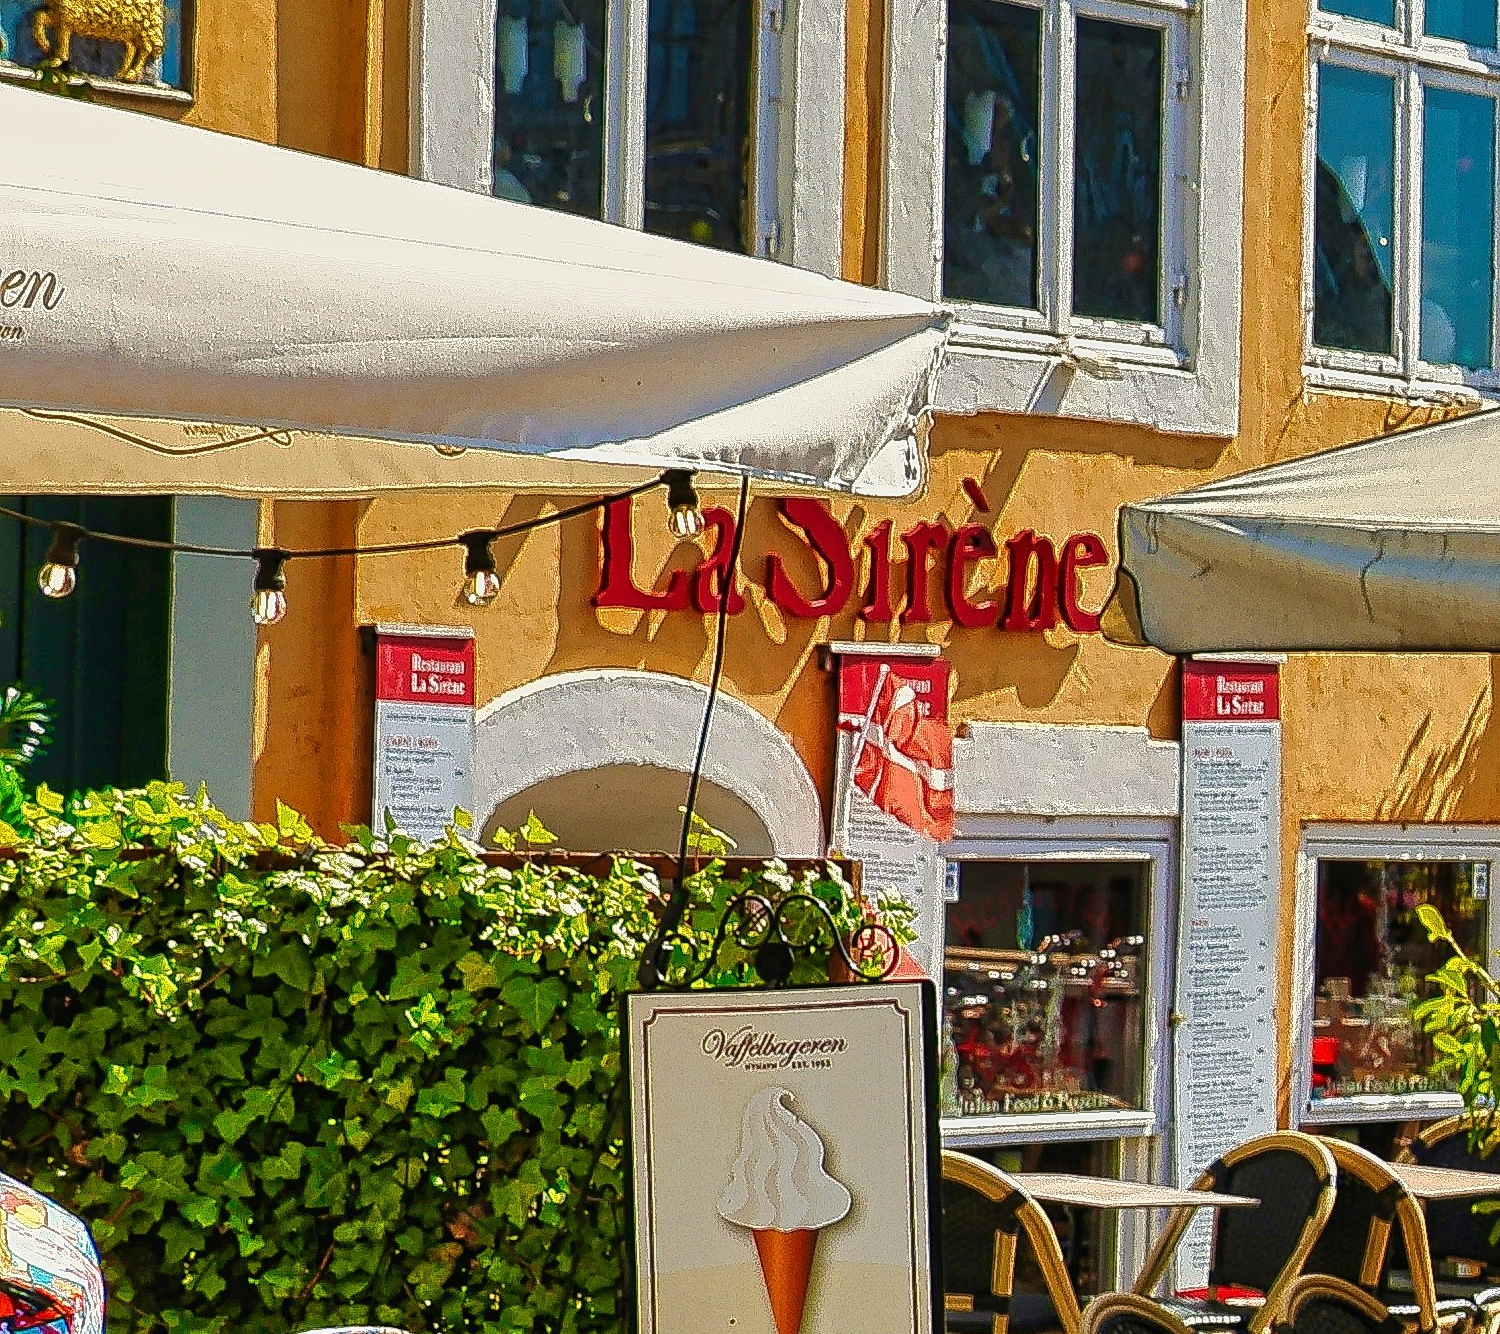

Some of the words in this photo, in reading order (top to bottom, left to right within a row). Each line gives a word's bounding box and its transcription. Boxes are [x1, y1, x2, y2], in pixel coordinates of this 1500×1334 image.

[591, 495, 744, 615] La
[766, 478, 1112, 633] Sirène
[702, 1025, 848, 1067] Vaffelbageren
